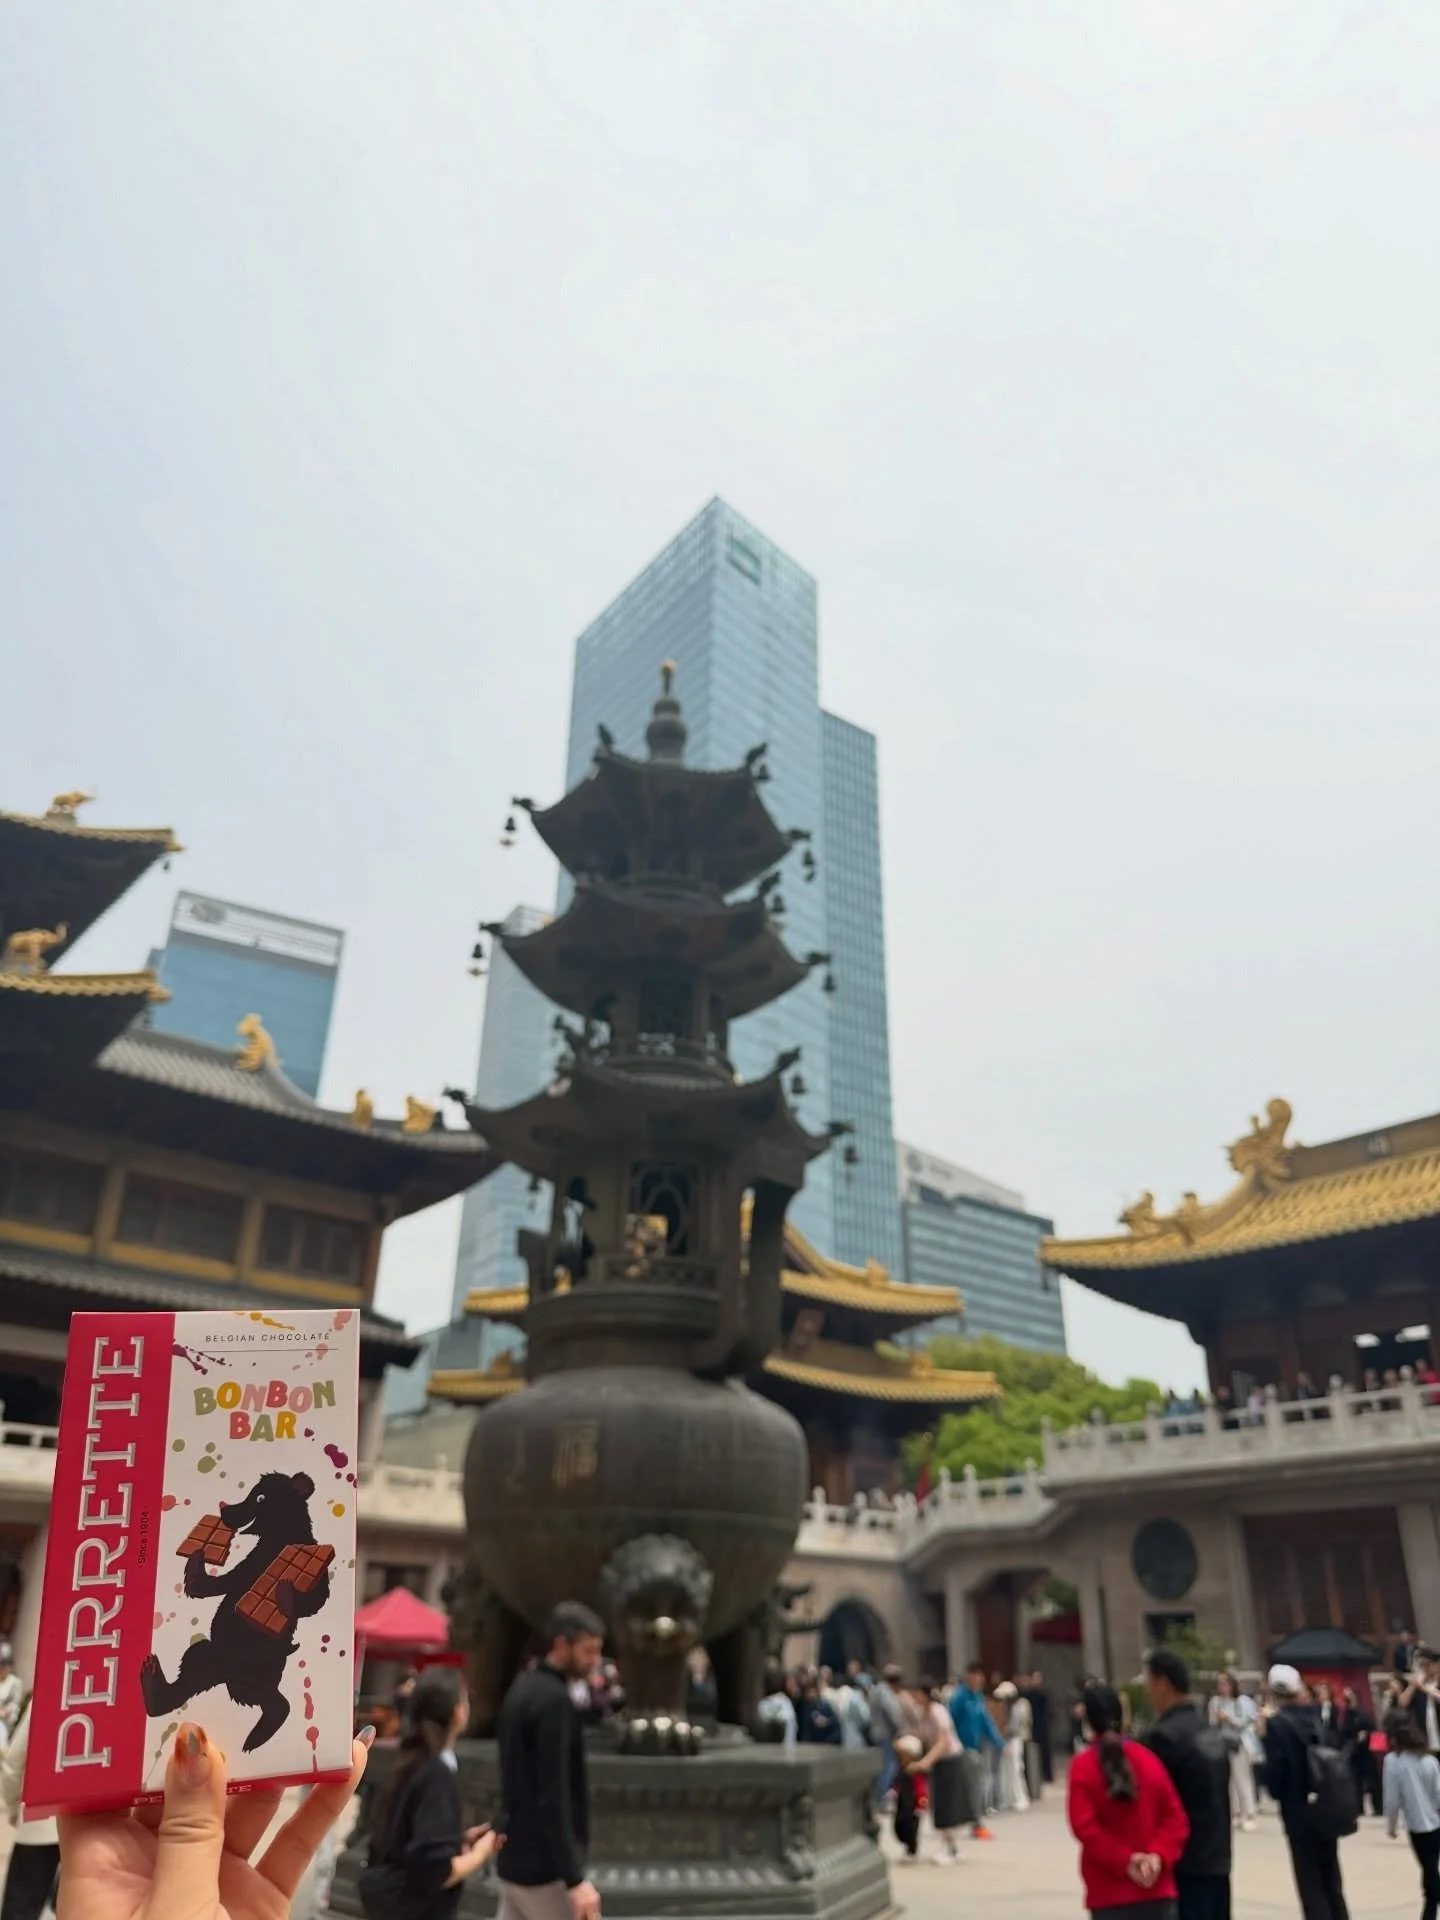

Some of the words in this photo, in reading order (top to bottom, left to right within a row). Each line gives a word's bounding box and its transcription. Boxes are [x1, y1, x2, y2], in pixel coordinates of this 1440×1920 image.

[205, 1334, 255, 1343] BELGIAN
[261, 1332, 330, 1341] CHOCOLATE
[193, 1379, 337, 1416] BONBON
[229, 1410, 297, 1442] BAR
[140, 1511, 149, 1534] 1904
[54, 1336, 145, 1773] PERRETTE
[137, 1539, 148, 1564] Since
